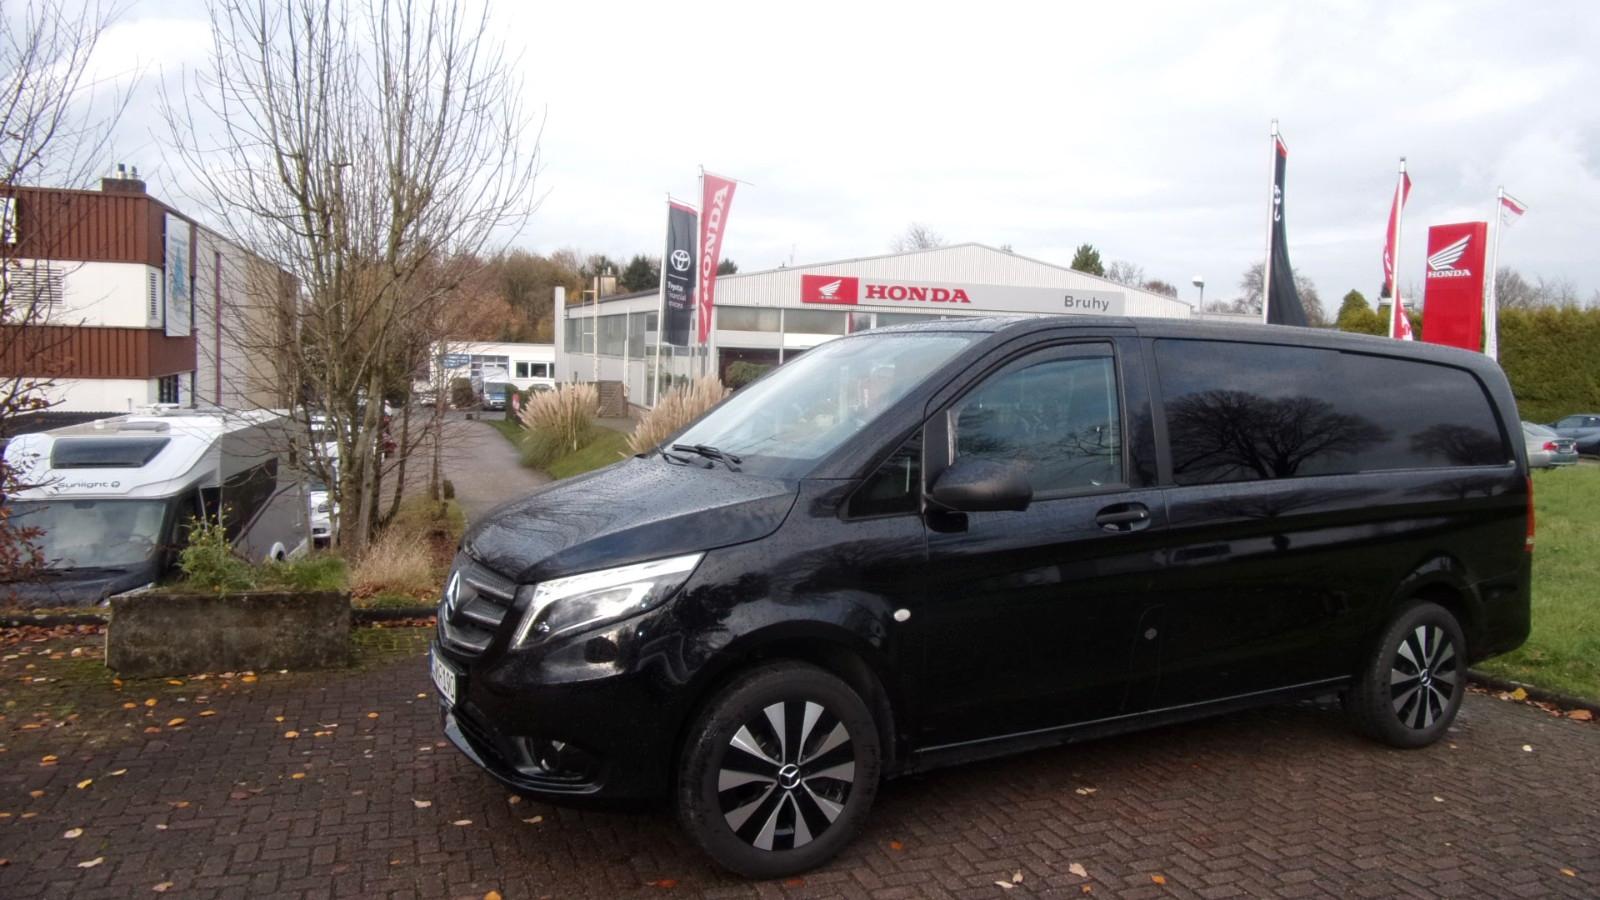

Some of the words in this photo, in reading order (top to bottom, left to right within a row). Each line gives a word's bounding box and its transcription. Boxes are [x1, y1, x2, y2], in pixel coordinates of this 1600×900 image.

[1427, 269, 1472, 279] HONDA
[864, 284, 972, 304] HONDA
[1064, 295, 1110, 312] Bruhy
